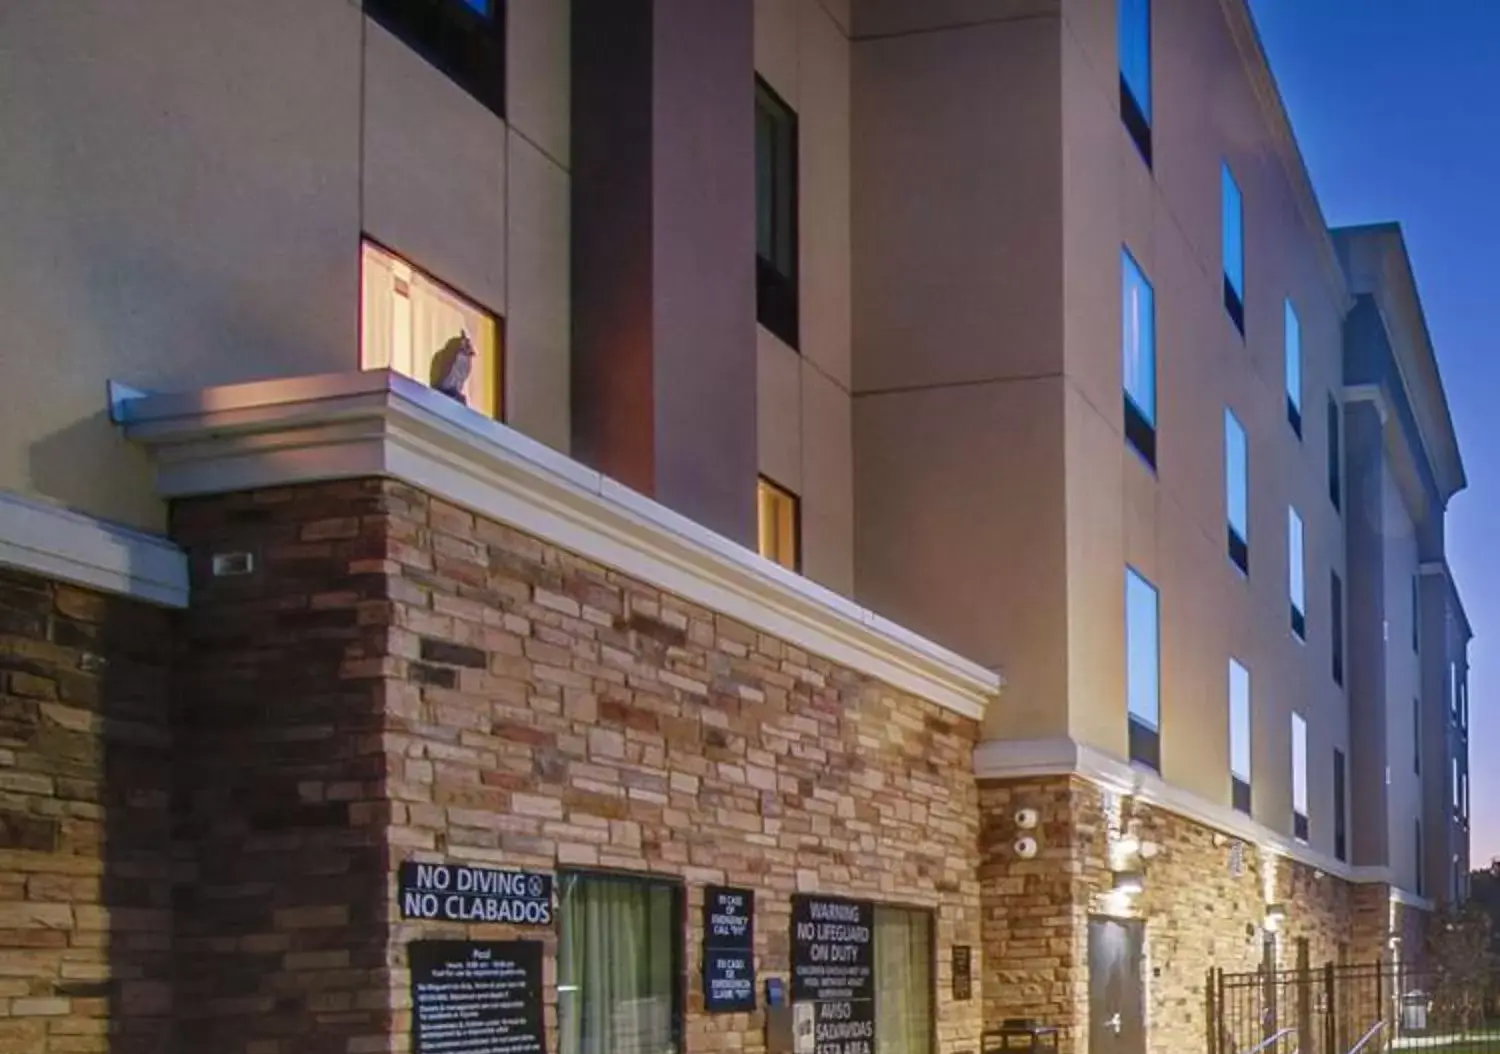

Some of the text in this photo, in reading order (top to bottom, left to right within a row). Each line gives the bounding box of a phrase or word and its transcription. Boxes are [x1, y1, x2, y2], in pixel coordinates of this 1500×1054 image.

[417, 865, 525, 896] NO DIVING
[404, 892, 550, 924] NO CLABADOS
[809, 900, 859, 922] WARNING
[797, 922, 869, 942] NO LIFEGUARD
[810, 944, 859, 962] ON DUTY
[821, 1002, 851, 1019] AVISO
